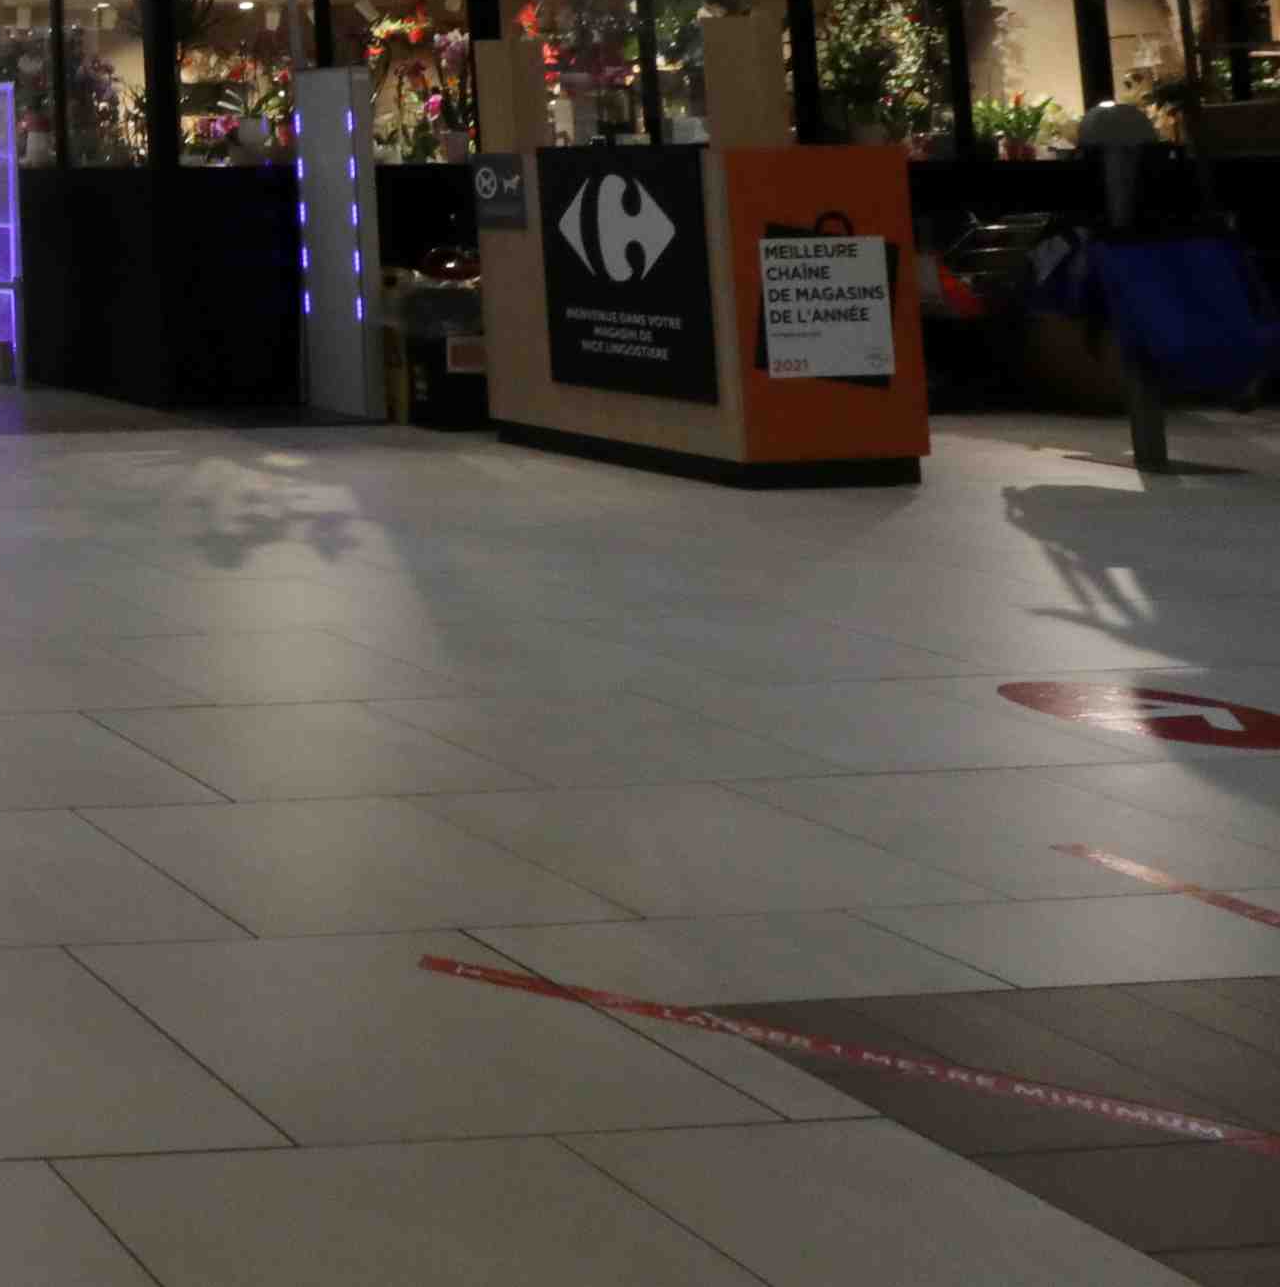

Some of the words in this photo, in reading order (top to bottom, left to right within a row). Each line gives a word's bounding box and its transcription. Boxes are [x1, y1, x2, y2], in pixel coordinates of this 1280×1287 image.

[765, 244, 859, 260] MEILLEURE
[767, 263, 831, 281] CHAÎNE
[768, 288, 792, 303] DE
[796, 285, 884, 301] MAGASINS
[770, 309, 793, 324] DE
[798, 304, 871, 323] L'ANNÉE
[773, 359, 809, 372] 2021
